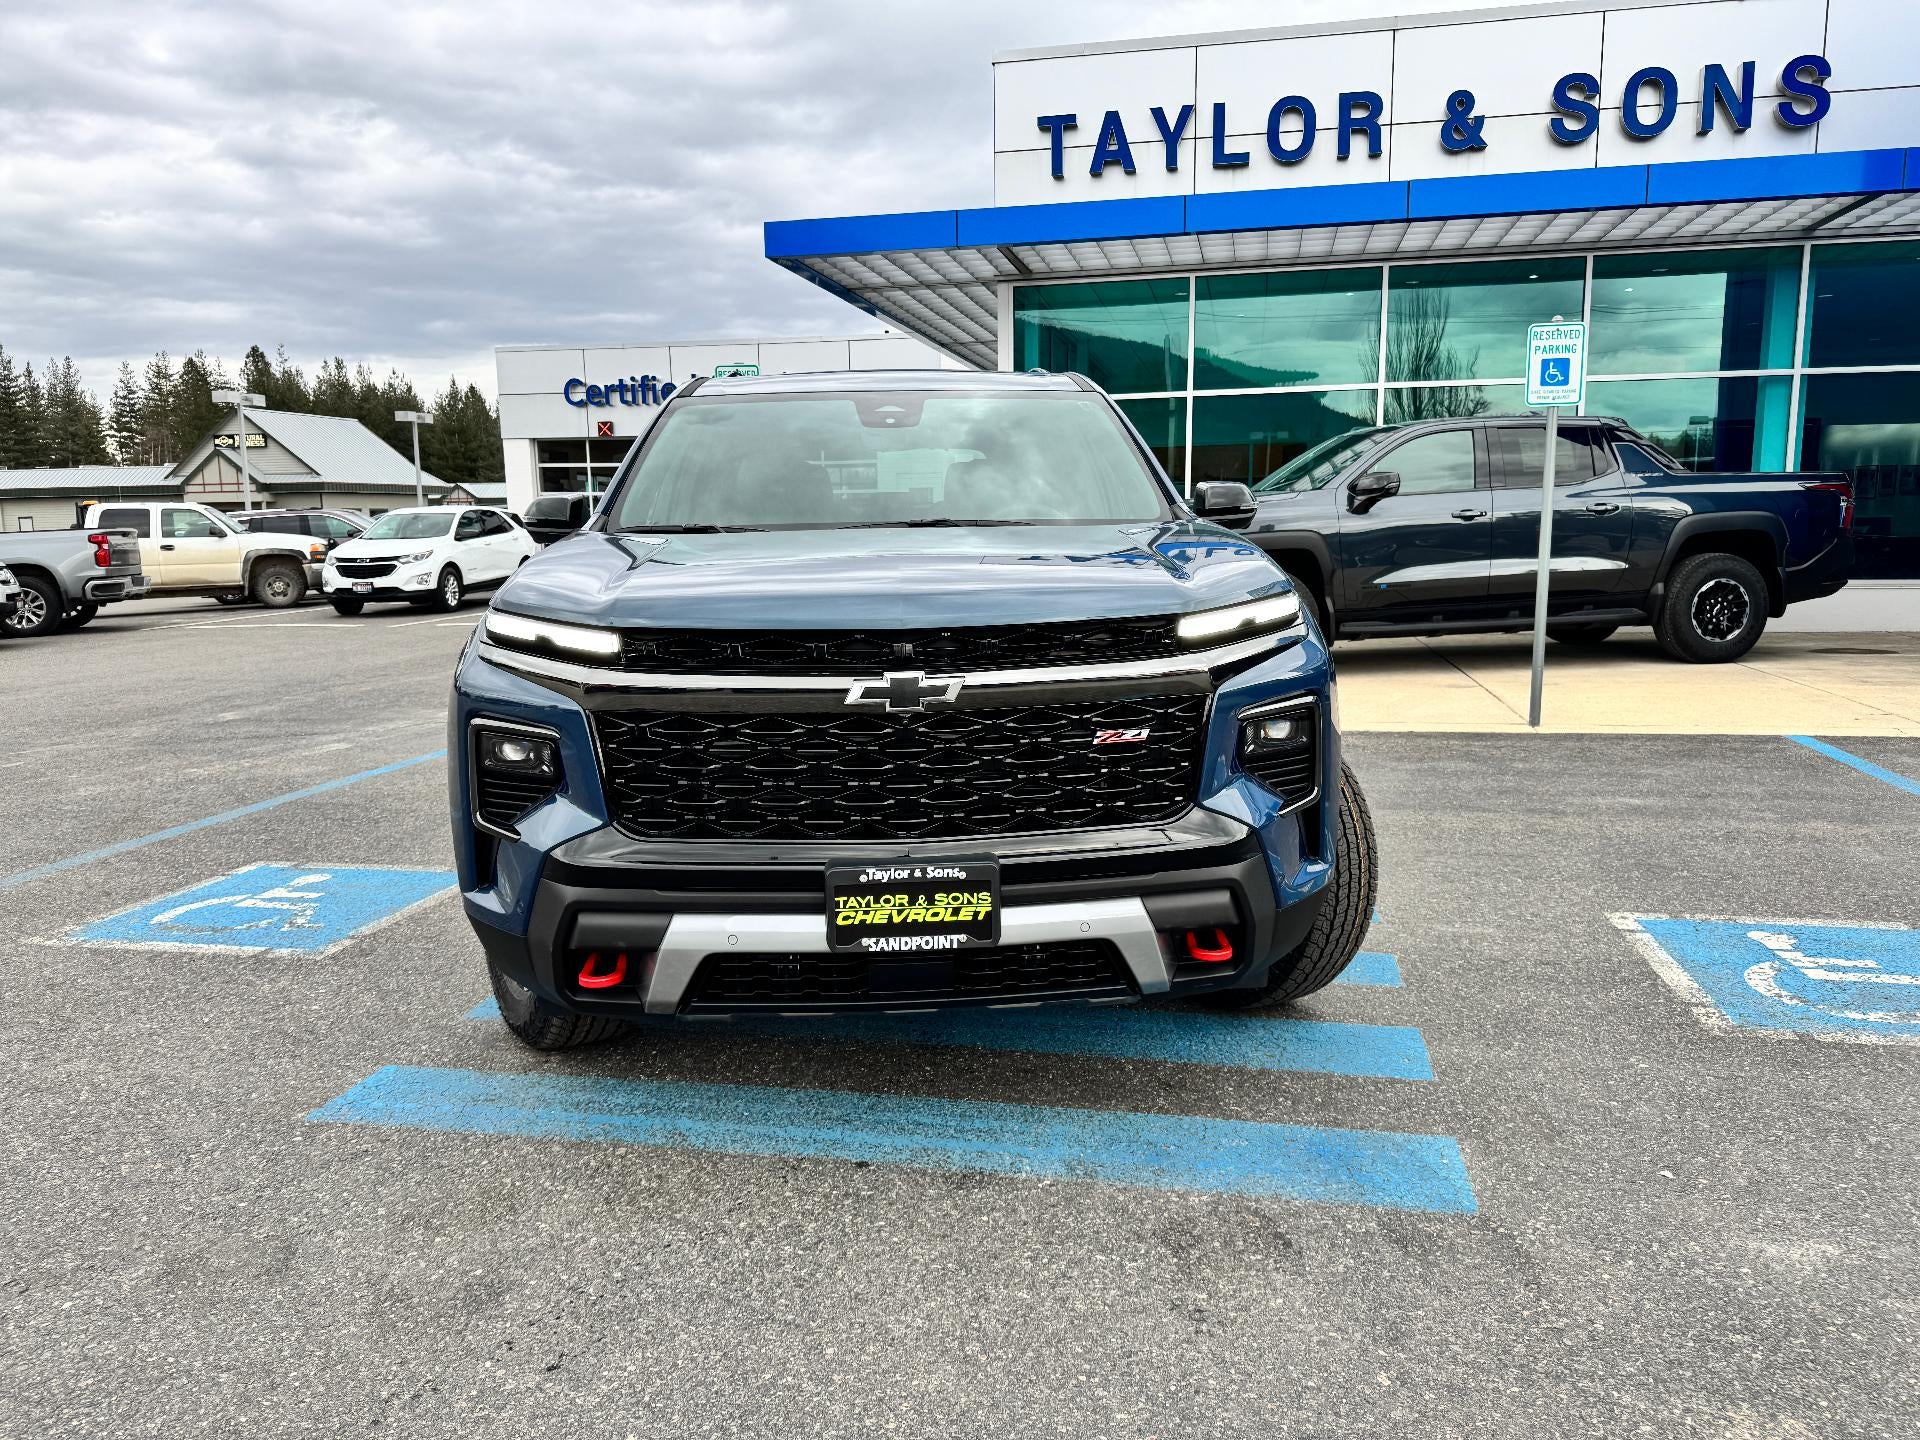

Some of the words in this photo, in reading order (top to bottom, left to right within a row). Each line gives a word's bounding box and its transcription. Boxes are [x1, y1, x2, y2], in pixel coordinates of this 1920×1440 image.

[1037, 91, 1384, 179] TAYLOR
[1440, 90, 1488, 151] &
[1548, 54, 1832, 144] SONS
[1533, 329, 1581, 341] RESERVED
[1535, 344, 1577, 355] PARKING
[563, 374, 697, 408] Certifie
[865, 868, 910, 882] Taylor
[914, 869, 923, 878] &
[926, 867, 960, 878] Sons
[835, 894, 909, 909] TAYLOR
[915, 895, 928, 908] &
[934, 892, 991, 906] SONS
[836, 907, 992, 926] CHEVROLET
[868, 935, 960, 951] SANDPOINT
